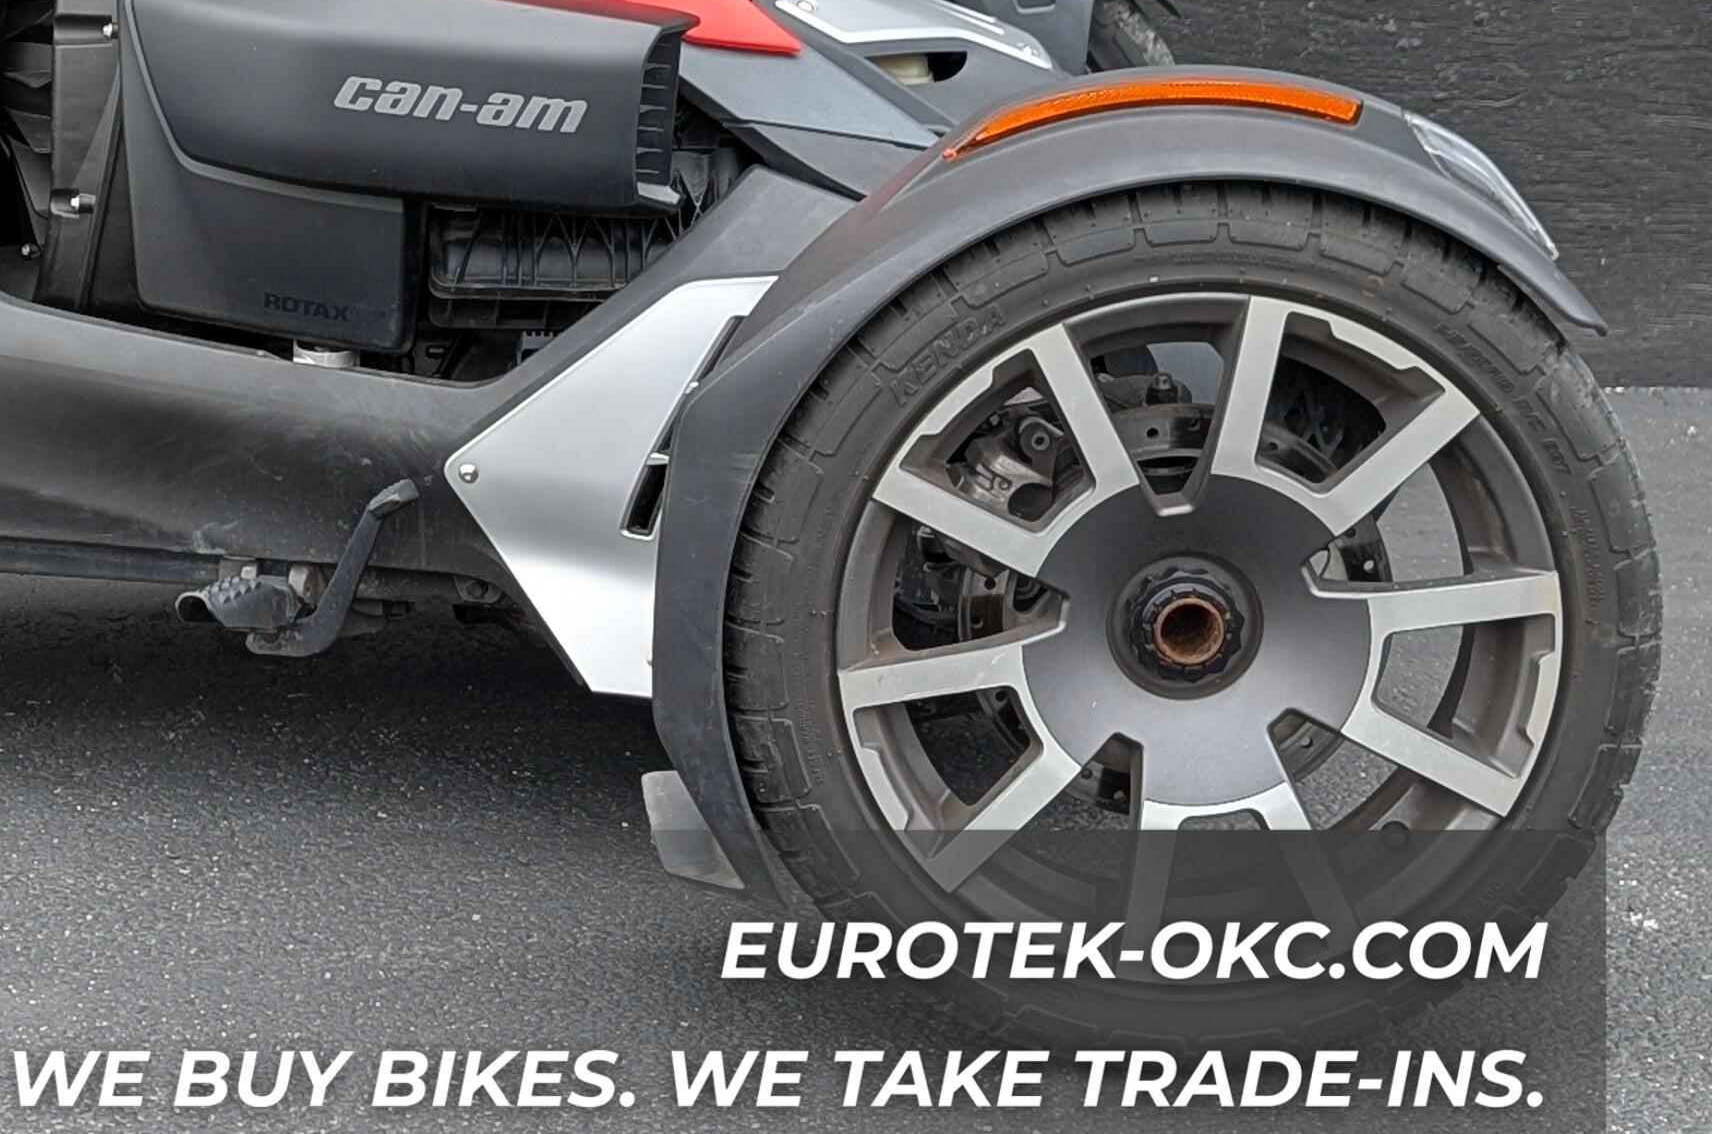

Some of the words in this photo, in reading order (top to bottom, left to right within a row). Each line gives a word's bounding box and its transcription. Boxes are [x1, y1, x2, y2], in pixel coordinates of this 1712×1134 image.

[334, 76, 588, 134] can-am
[263, 291, 350, 323] ROTAX
[888, 302, 1007, 407] KENDA
